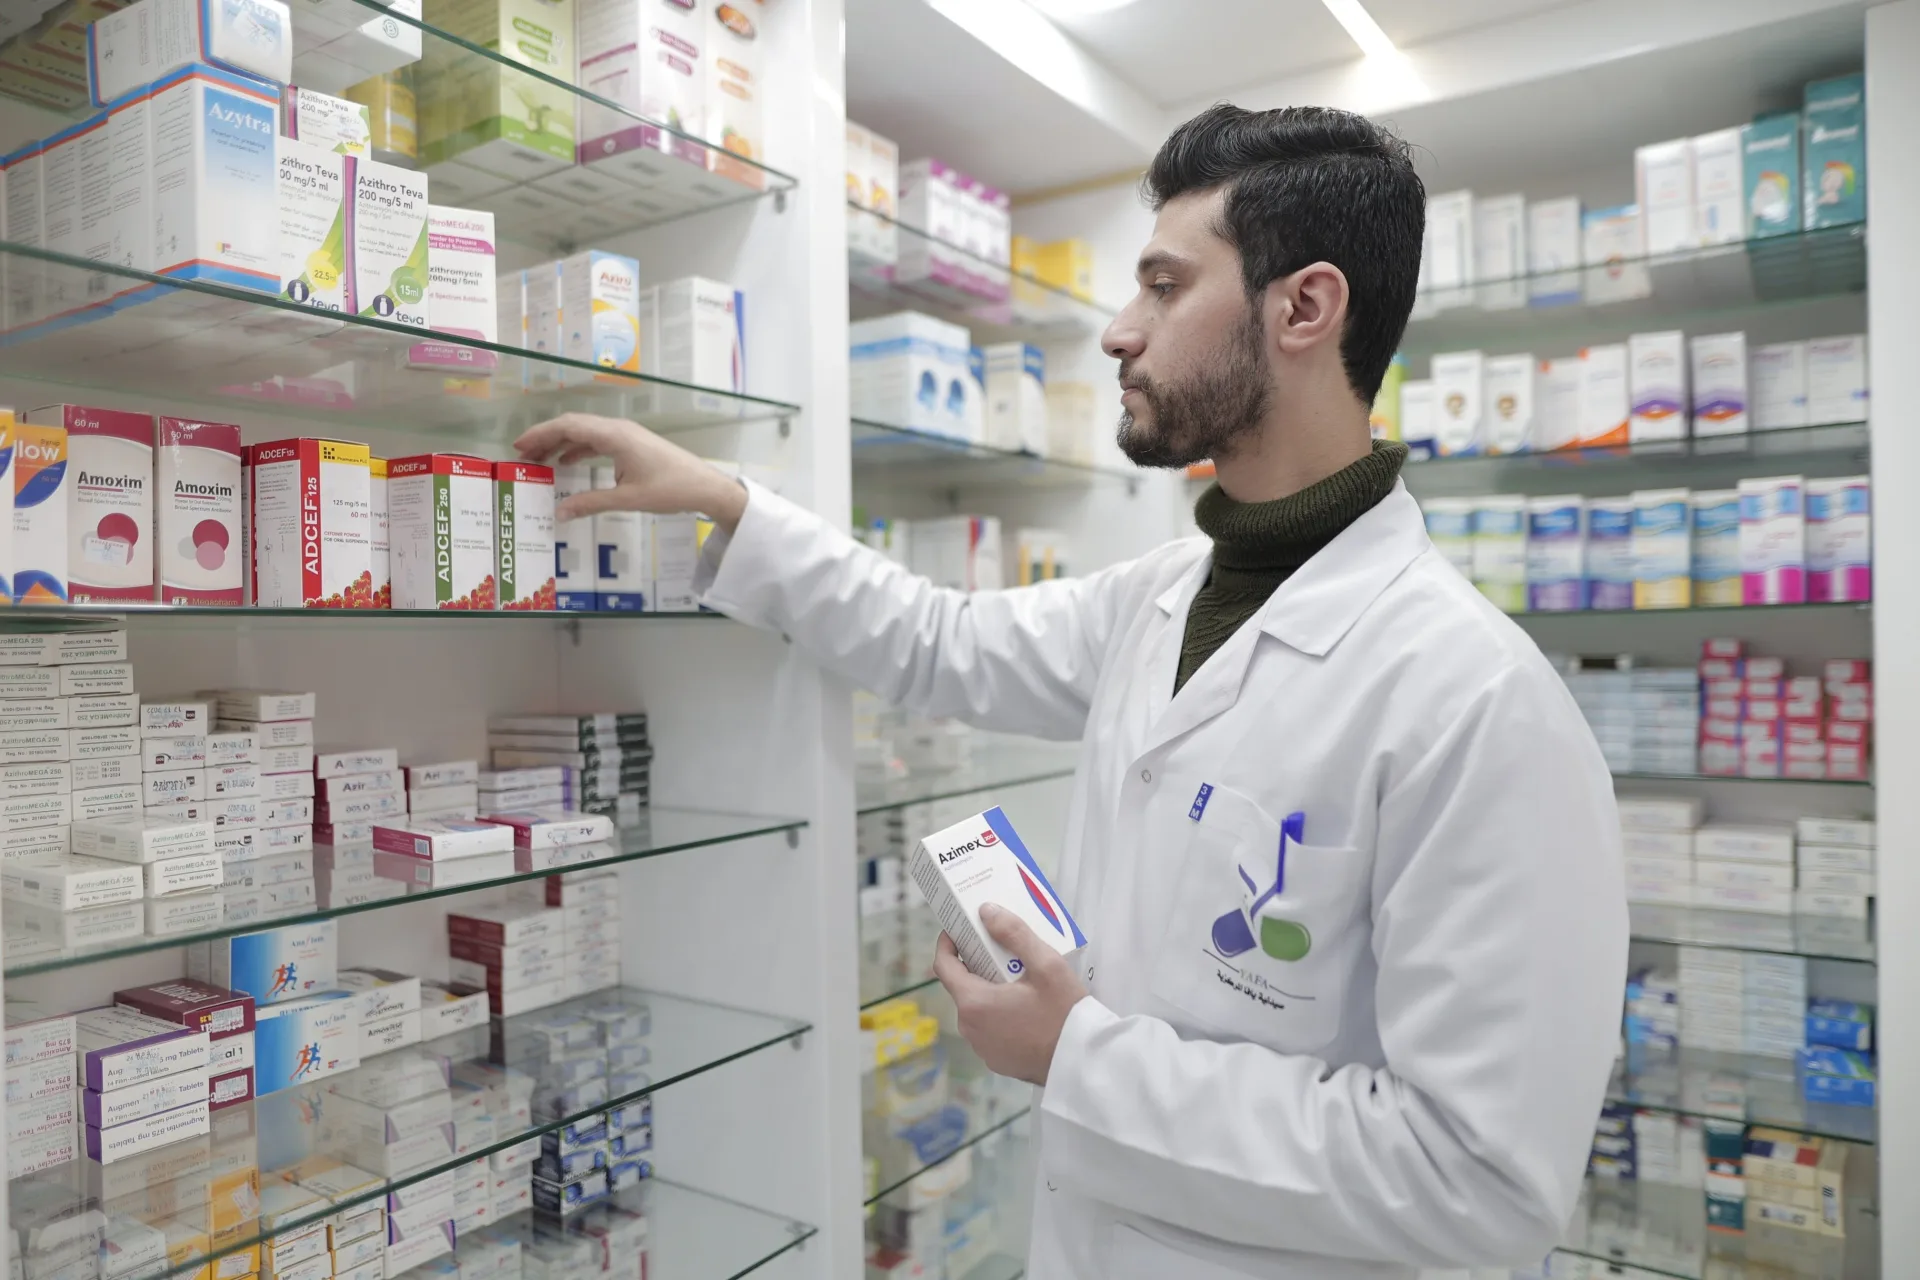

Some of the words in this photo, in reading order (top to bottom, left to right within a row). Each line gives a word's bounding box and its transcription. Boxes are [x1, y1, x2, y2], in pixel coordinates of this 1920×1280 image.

[300, 92, 329, 107] Azithro
[330, 100, 349, 113] Teva
[301, 102, 316, 113] 200
[208, 102, 272, 135] Azytra
[280, 155, 312, 173] zithro
[315, 163, 339, 182] Teva
[280, 168, 292, 181] 00
[293, 176, 317, 188] mg/5
[319, 182, 329, 192] ml
[359, 175, 397, 193] Azithro
[400, 184, 424, 200] Teva
[359, 188, 377, 202] 200
[379, 196, 401, 208] mg/5
[403, 200, 413, 210] ml
[429, 265, 483, 279] zithromycin
[401, 284, 419, 298] 15ml
[310, 297, 341, 312] teva
[396, 310, 424, 326] teva
[74, 419, 86, 429] 60
[88, 420, 100, 429] ml
[171, 430, 182, 440] 60
[184, 432, 193, 440] ml
[259, 449, 286, 461] ADCEF
[393, 463, 418, 474] ADCEF
[78, 470, 142, 490] Amoxim
[175, 479, 233, 497] Amoxim
[307, 476, 317, 497] 125
[440, 488, 448, 507] 250
[504, 493, 512, 513] 250
[305, 498, 319, 575] ADCEF
[437, 508, 450, 583] ADCEF
[501, 513, 513, 584] ADCEF
[938, 838, 982, 865] Azimex
[1241, 968, 1269, 990] YAFA
[165, 1054, 178, 1062] mg
[179, 1047, 205, 1058] Tablets
[179, 1081, 205, 1093] Tablets
[167, 1116, 206, 1132] Augmentin
[138, 1133, 150, 1141] mg
[152, 1129, 165, 1139] 875
[109, 1137, 137, 1150] Tablets
